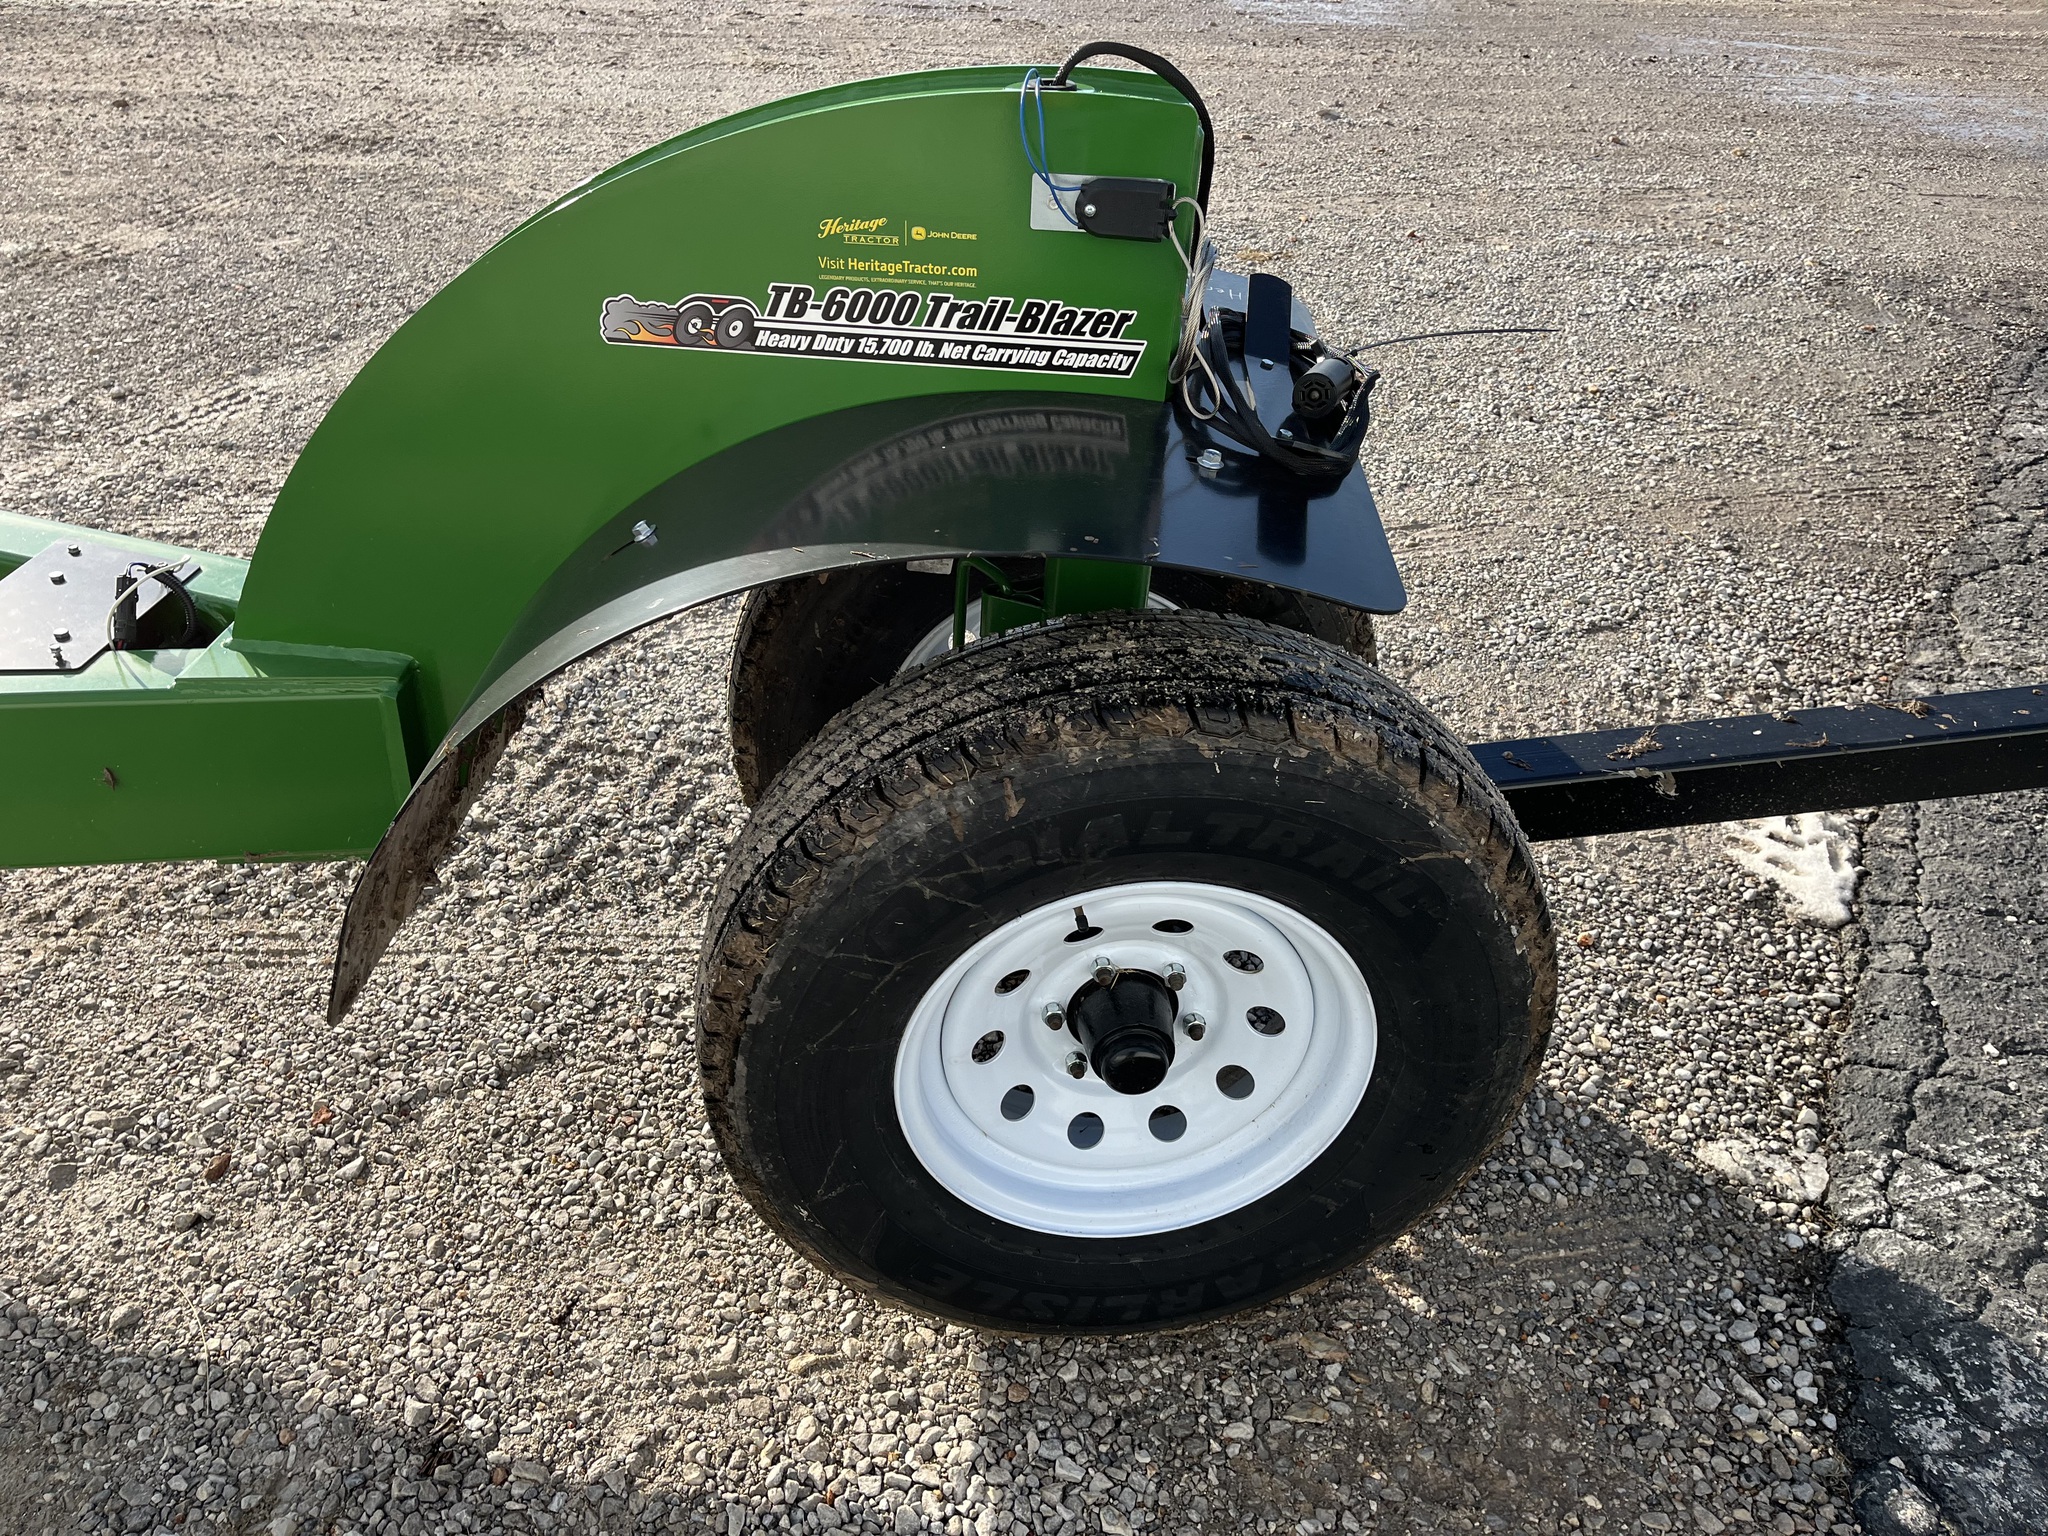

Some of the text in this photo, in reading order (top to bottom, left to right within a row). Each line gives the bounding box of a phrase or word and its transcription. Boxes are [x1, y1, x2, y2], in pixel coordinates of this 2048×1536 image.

[817, 216, 889, 239] Heritage
[927, 230, 978, 240] JOHN DEERE
[843, 234, 900, 245] TRACTOR
[818, 256, 978, 277] Visit HeritageTractor.com
[871, 277, 907, 285] EXTRAORDINARY
[765, 284, 1137, 340] TB-6000 Trail-Blazer
[754, 329, 1135, 372] Heavy Duty 15,700 lb. Net Carrying Capacity
